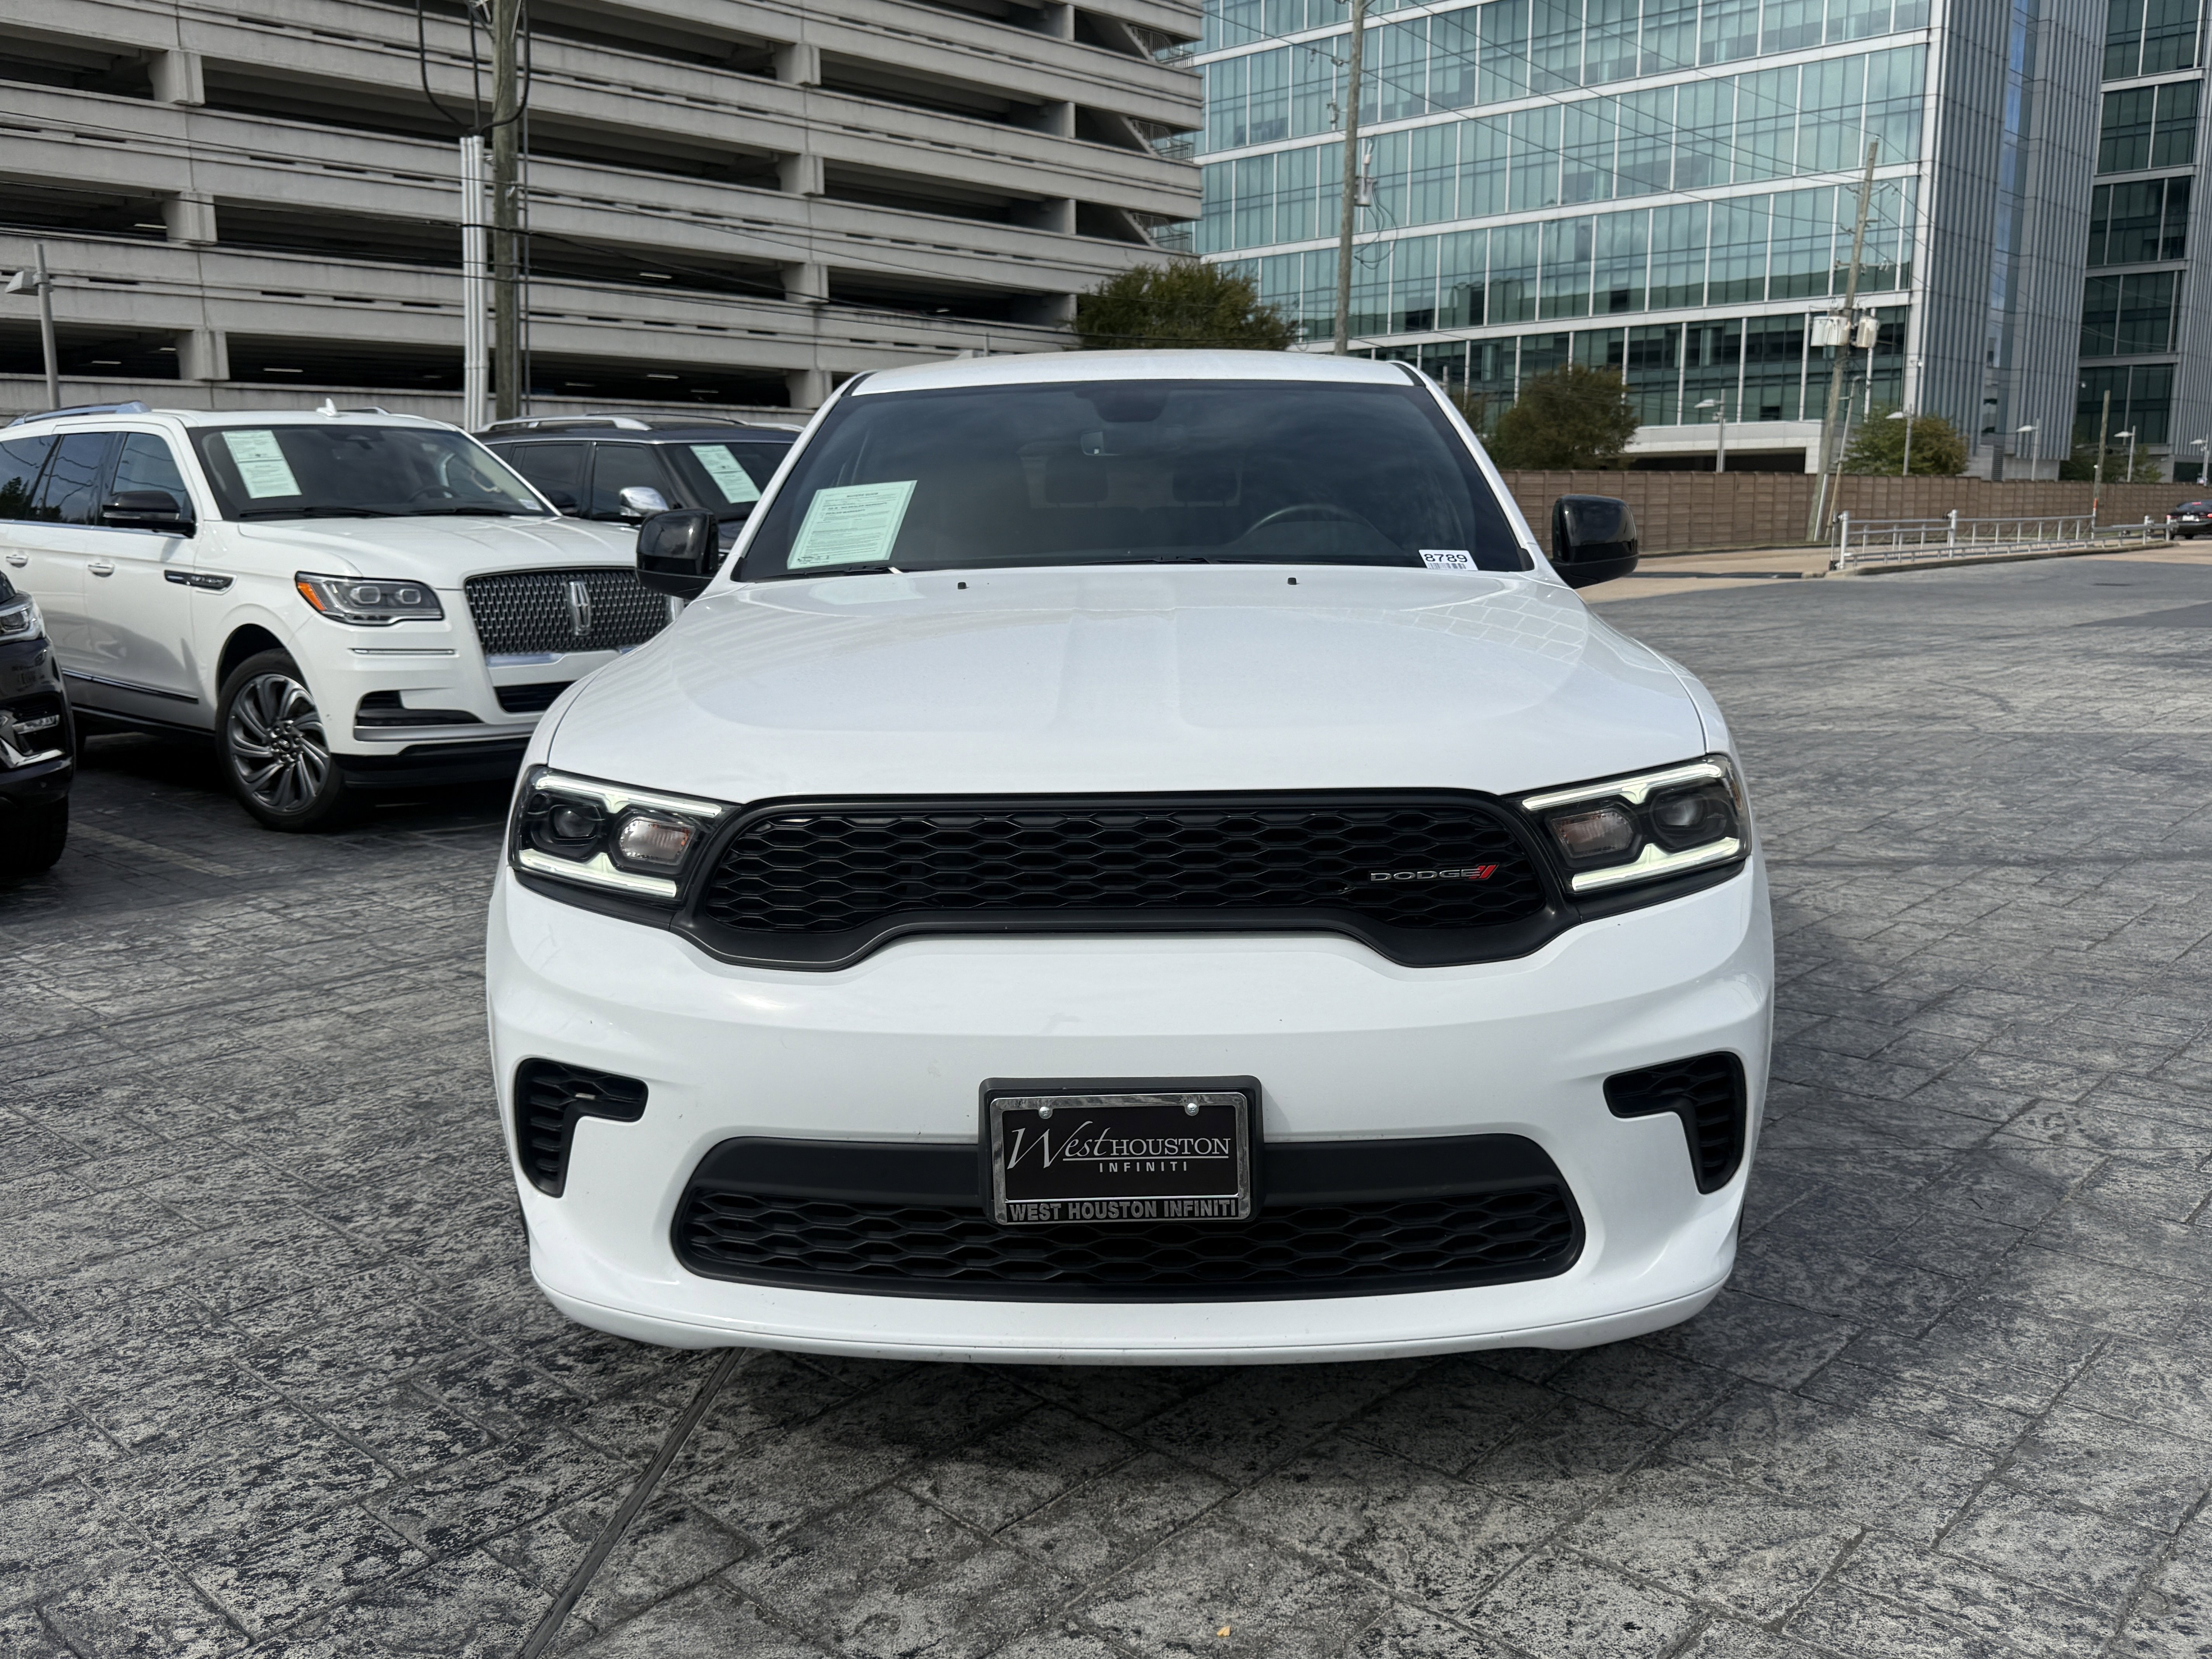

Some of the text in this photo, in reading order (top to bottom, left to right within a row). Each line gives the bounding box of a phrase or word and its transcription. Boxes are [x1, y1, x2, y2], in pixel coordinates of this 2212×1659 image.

[1424, 554, 1467, 562] 8789
[1371, 869, 1480, 881] DODGE
[1007, 1121, 1231, 1170] West HOUSTON
[1099, 1161, 1187, 1173] INFINITI
[1009, 1199, 1236, 1221] WEST HOUSTON INFINITI
